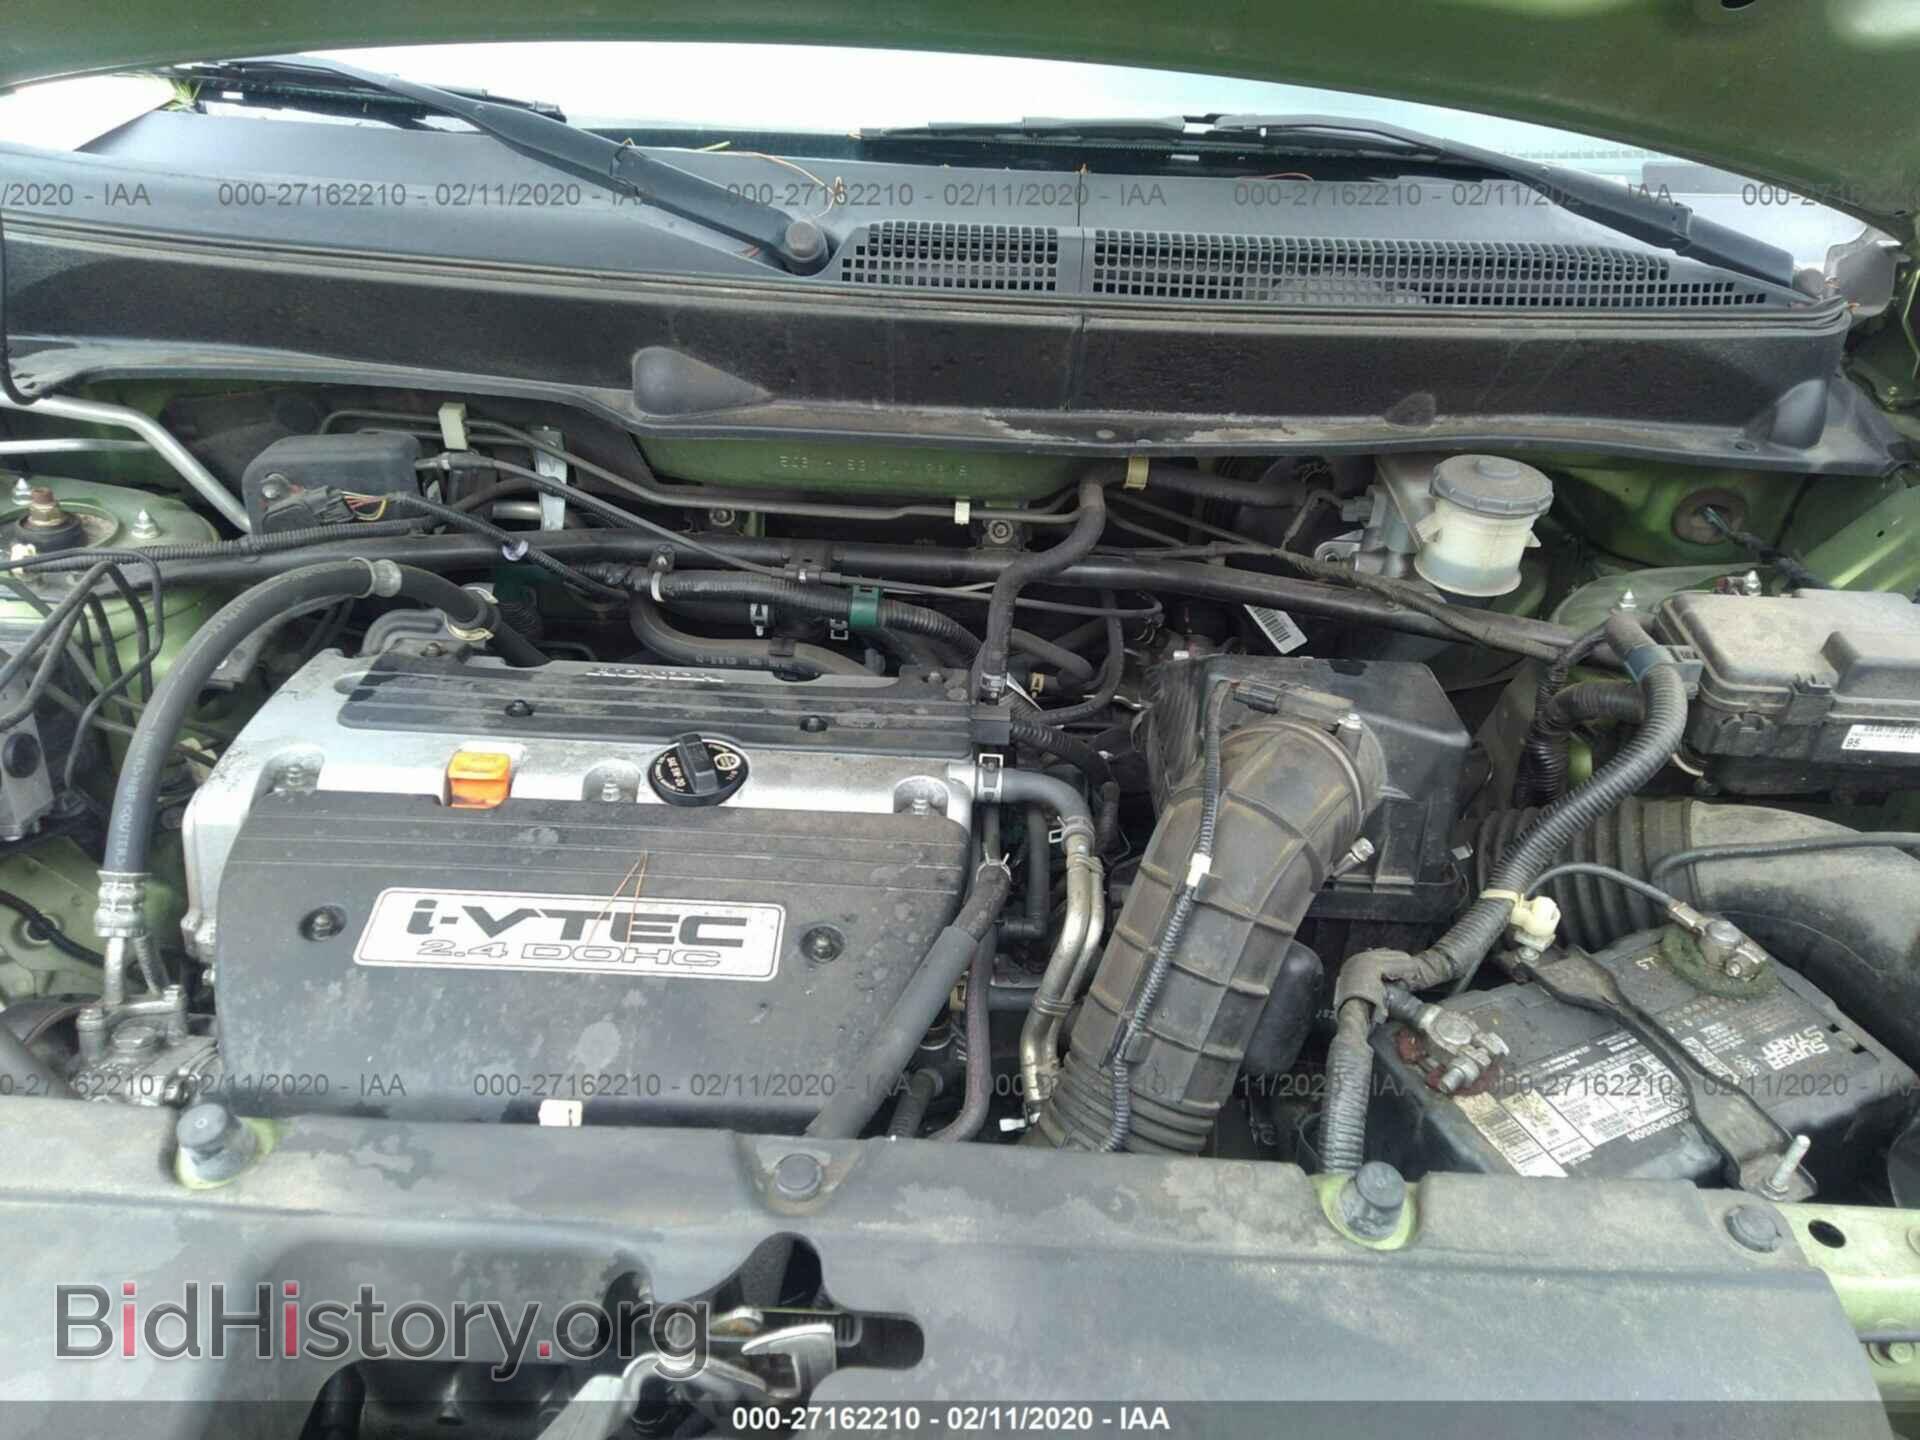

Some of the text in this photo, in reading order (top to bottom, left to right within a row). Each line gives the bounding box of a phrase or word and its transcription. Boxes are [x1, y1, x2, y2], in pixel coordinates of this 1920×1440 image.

[407, 899, 747, 948] i-VTEC
[417, 938, 721, 967] 2.4 DOHC
